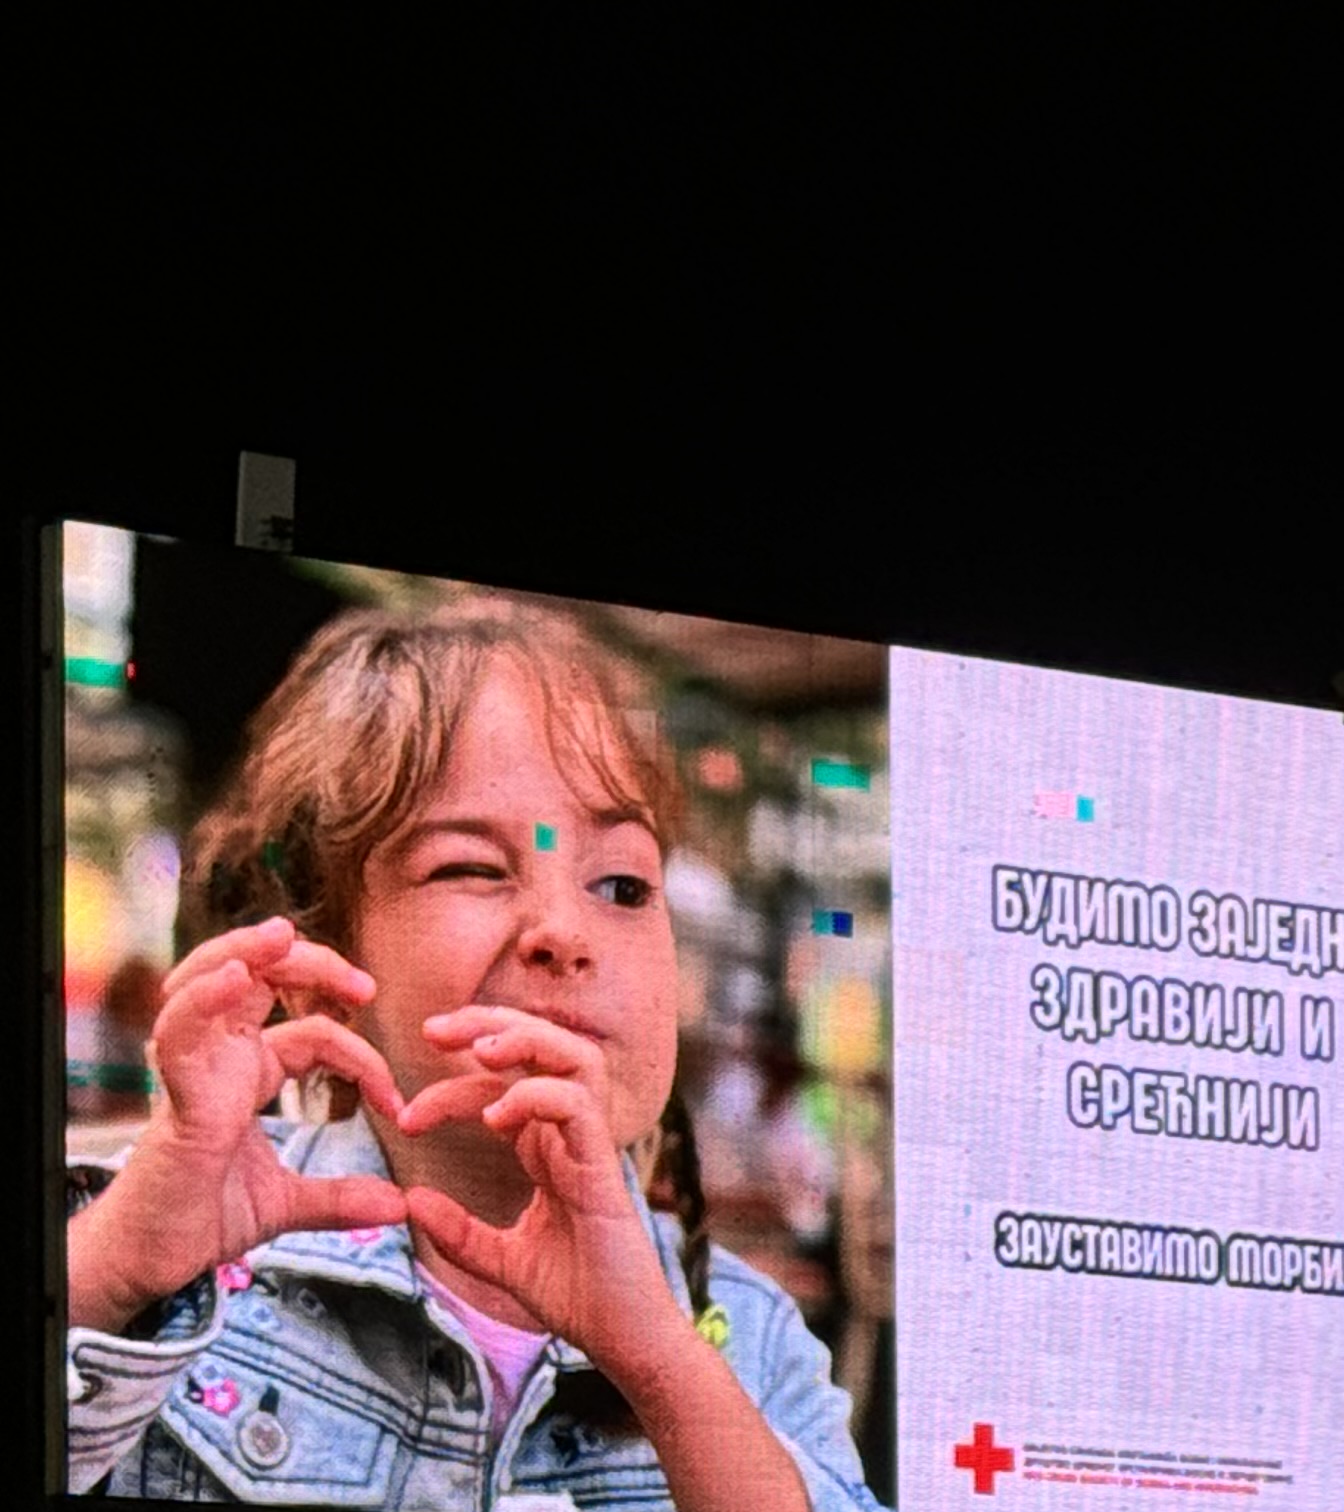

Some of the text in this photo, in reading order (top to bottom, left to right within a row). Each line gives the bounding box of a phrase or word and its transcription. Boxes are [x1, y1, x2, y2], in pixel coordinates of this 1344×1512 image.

[992, 864, 1181, 951] БУДИМО
[1030, 963, 1334, 1062] ЗДРАВИЈИ И
[1067, 1061, 1319, 1151] СРЕЋНИЈИ
[995, 1211, 1222, 1285] ЗАУСТАВИМО
